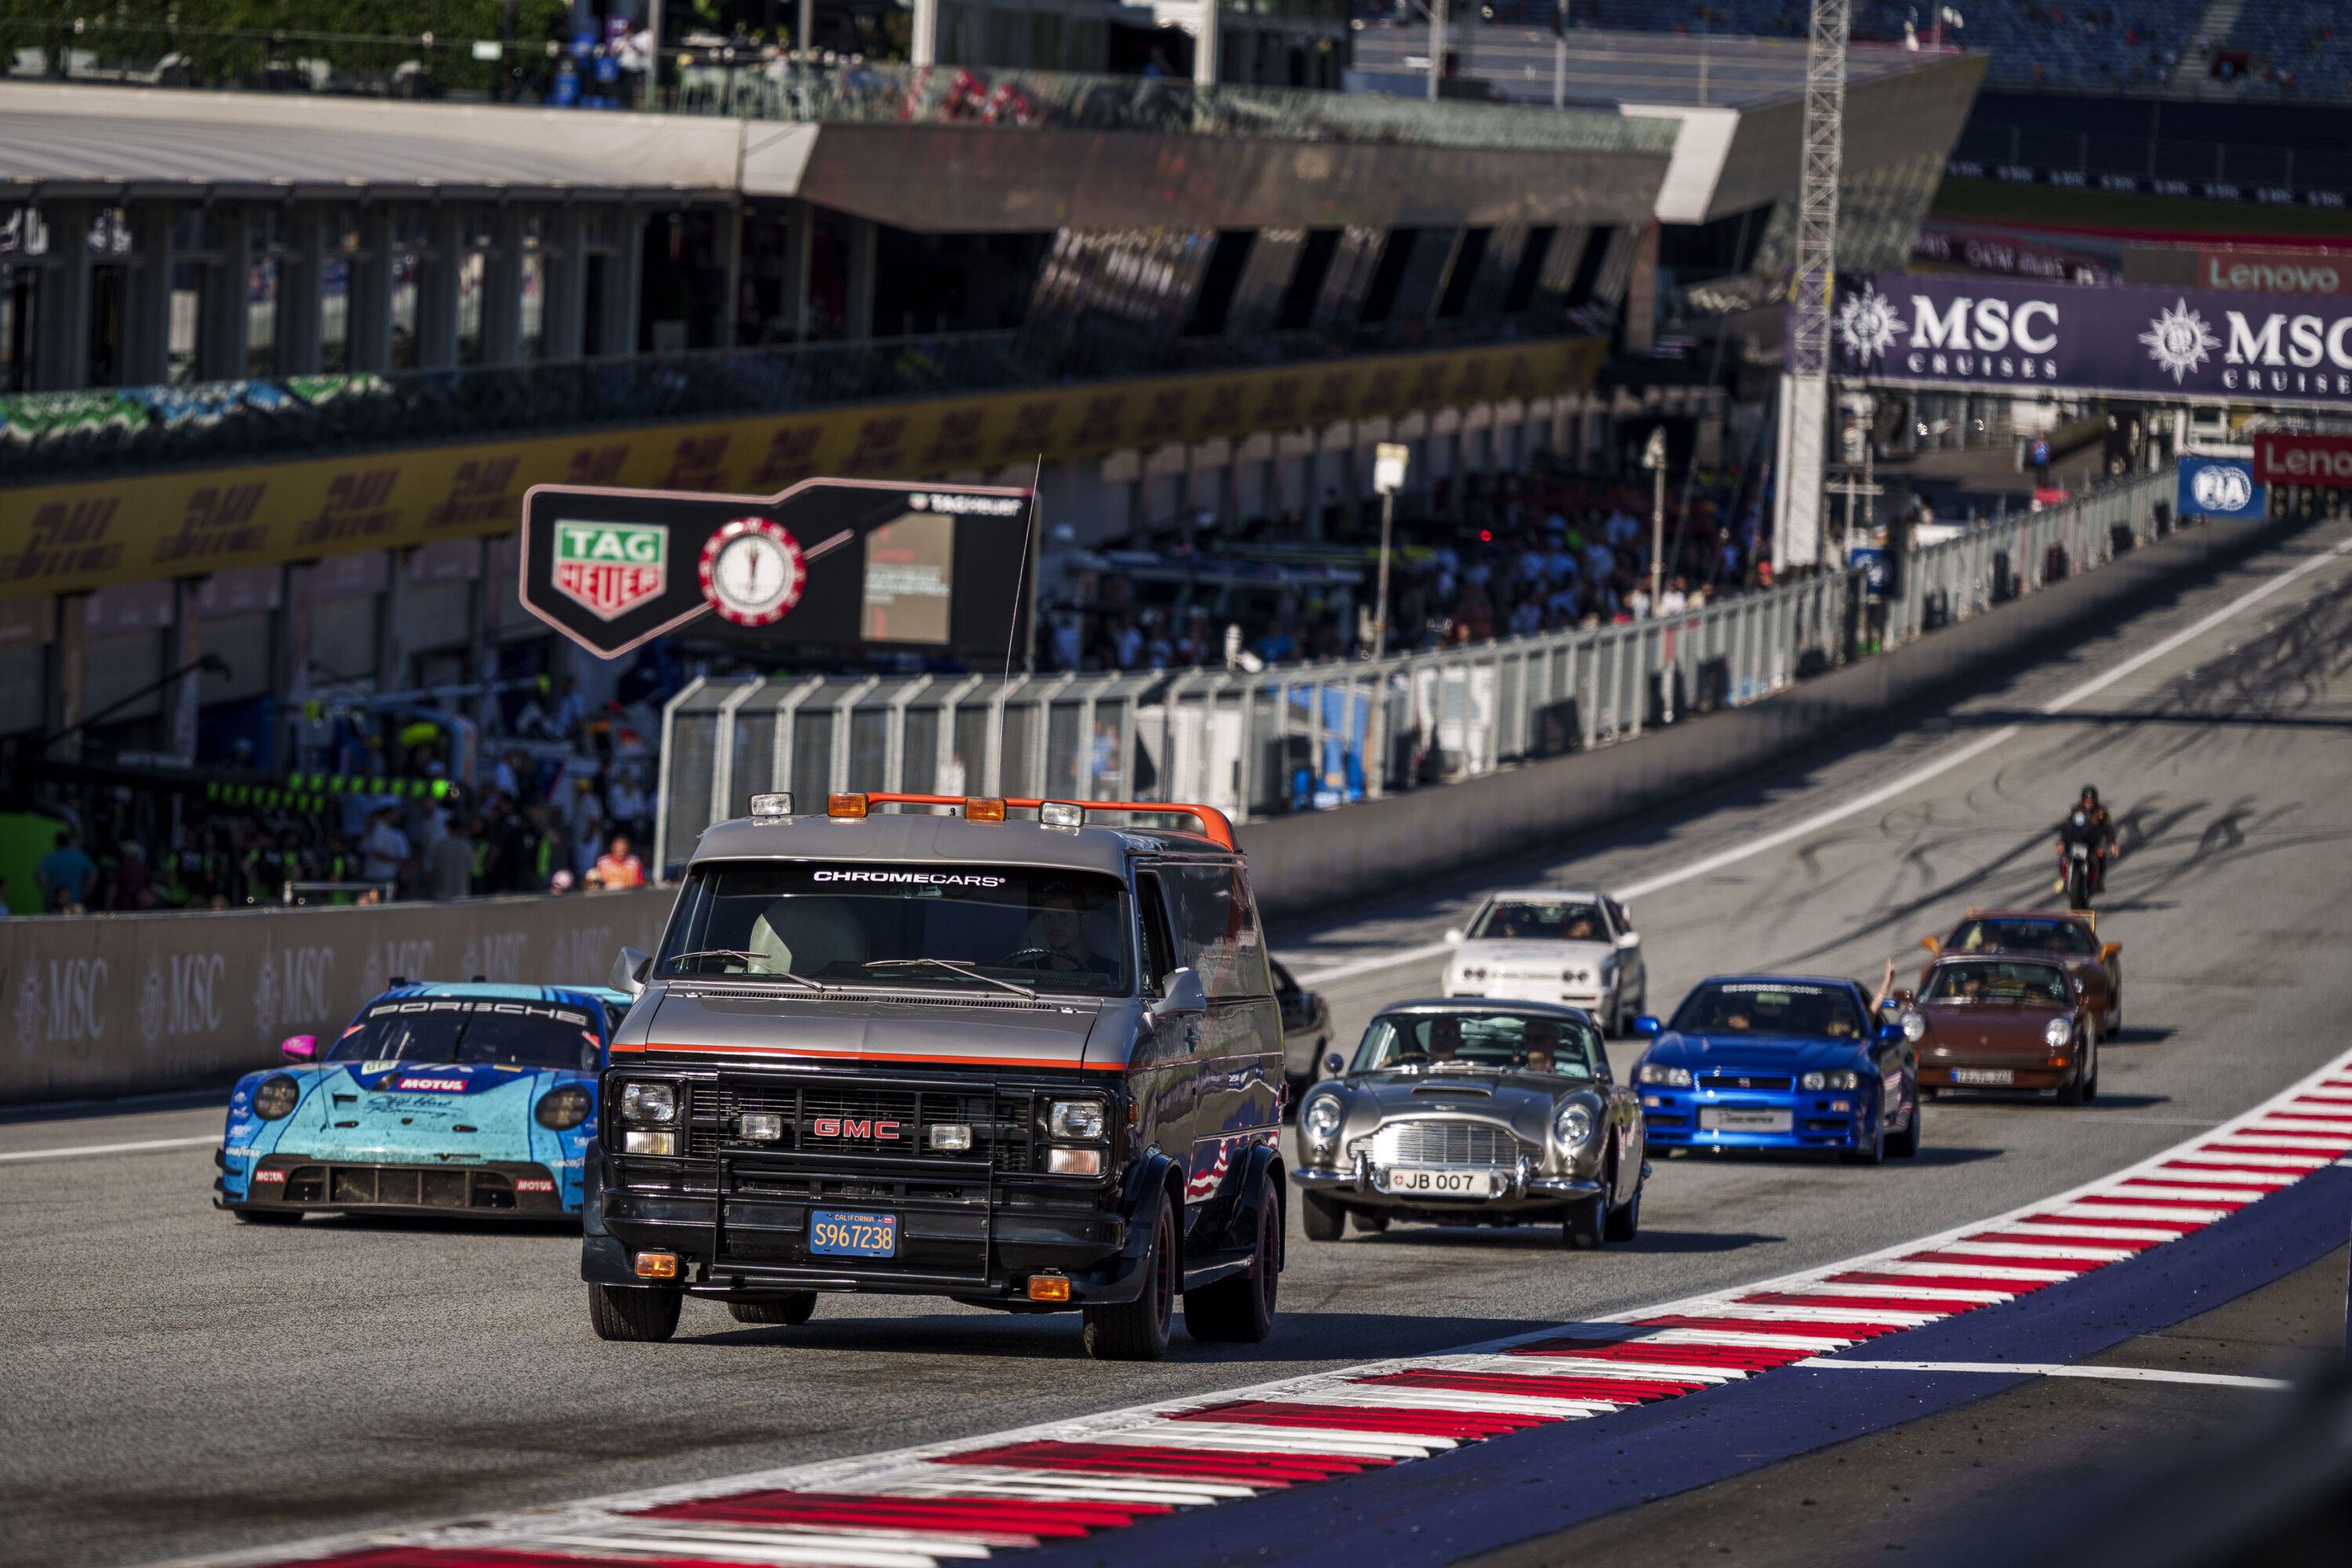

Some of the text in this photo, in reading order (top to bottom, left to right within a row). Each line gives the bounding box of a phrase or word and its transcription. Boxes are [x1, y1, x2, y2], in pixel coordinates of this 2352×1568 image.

[2210, 256, 2339, 293] Lenovo
[1908, 294, 2060, 354] MSC
[1907, 353, 2058, 379] CRUISES
[2195, 473, 2246, 502] FIA
[564, 530, 655, 561] TAG
[560, 564, 661, 612] HEUER
[45, 956, 109, 1041] MSC
[168, 953, 226, 1033] MSC
[281, 946, 335, 1024] MSC
[368, 1001, 589, 1026] PORSCHE
[400, 1078, 463, 1091] MOTUL
[815, 1118, 899, 1138] GMC
[256, 1171, 284, 1181] MOTUL
[517, 1181, 554, 1191] MOTUL
[1406, 1174, 1474, 1191] JB 007
[834, 1214, 875, 1223] CALIFORNIA
[814, 1223, 893, 1250] S967238
